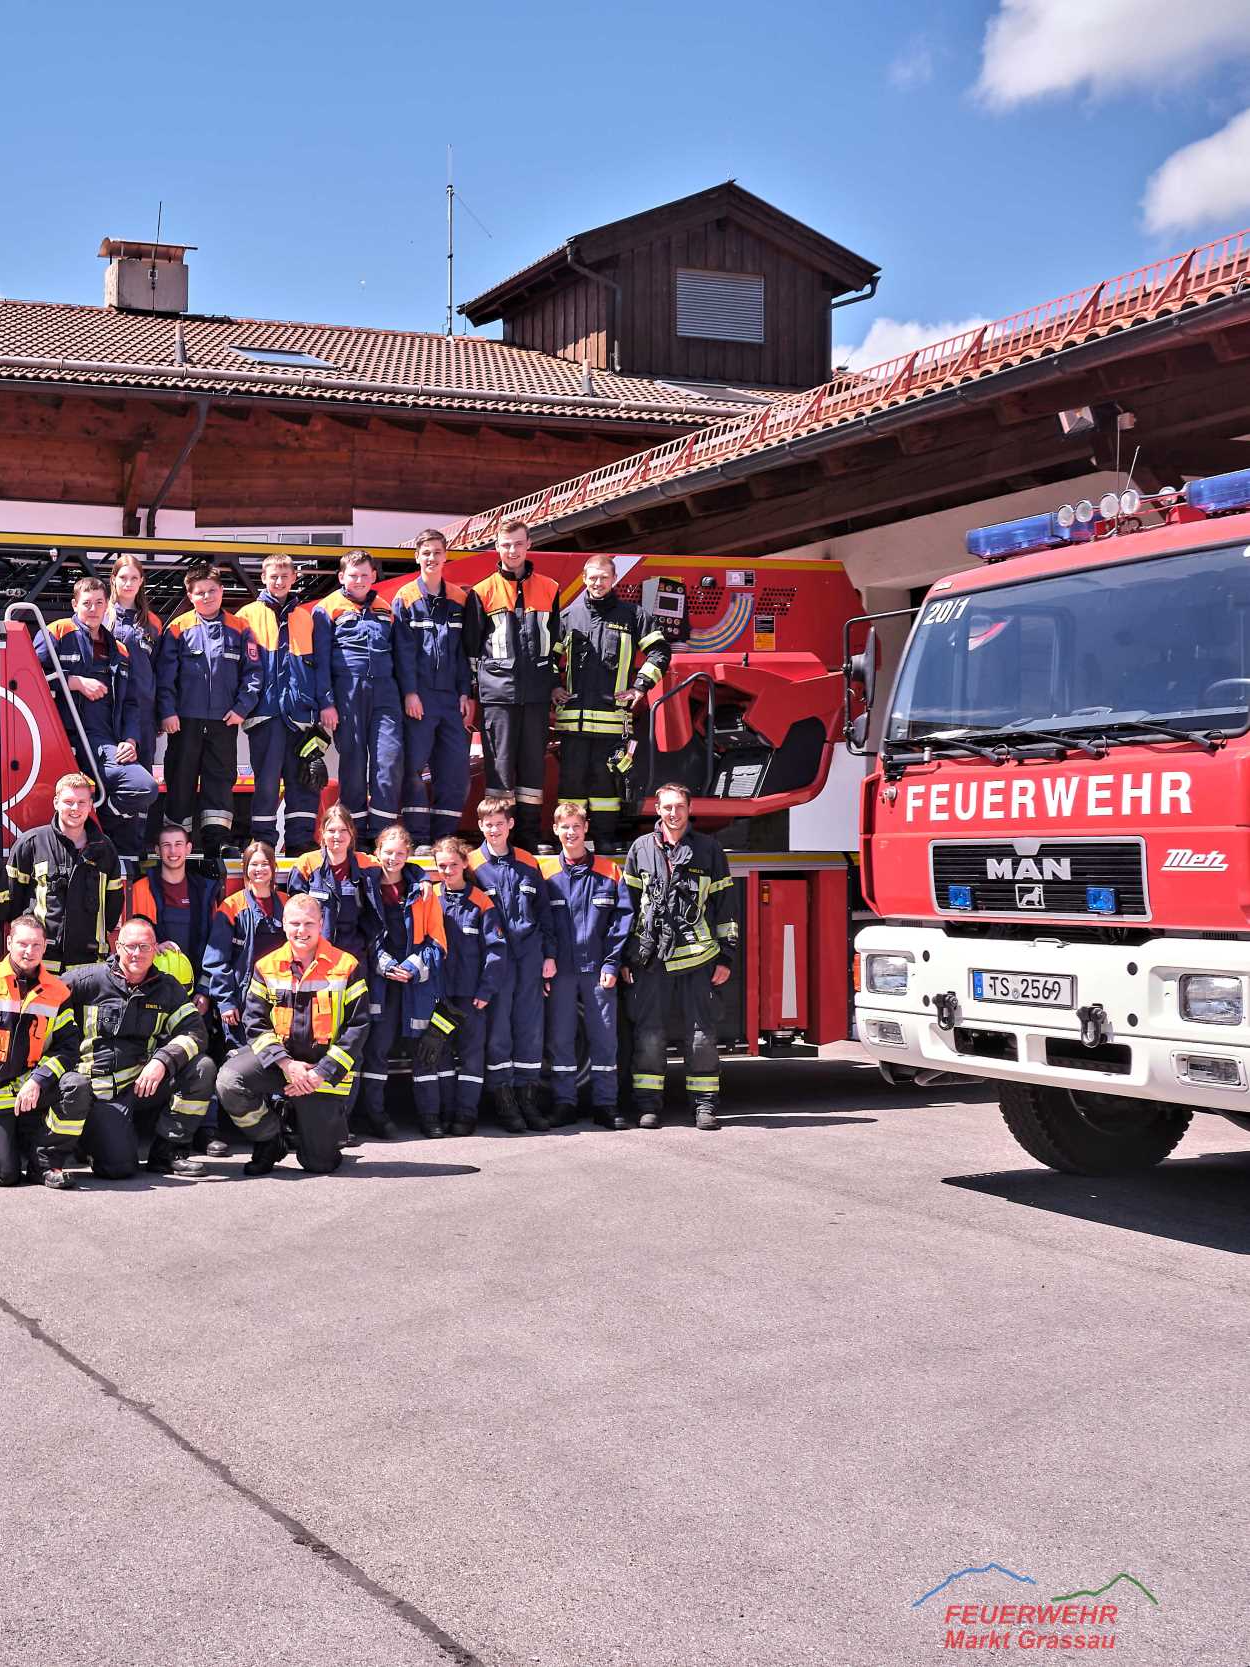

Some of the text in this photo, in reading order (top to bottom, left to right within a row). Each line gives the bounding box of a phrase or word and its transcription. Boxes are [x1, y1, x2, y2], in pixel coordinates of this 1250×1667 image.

[922, 597, 971, 626] 20/1
[905, 771, 1193, 822] FEUERWEHR
[986, 858, 1071, 881] MAN
[989, 976, 1010, 997] TS
[1021, 978, 1061, 1001] 2569
